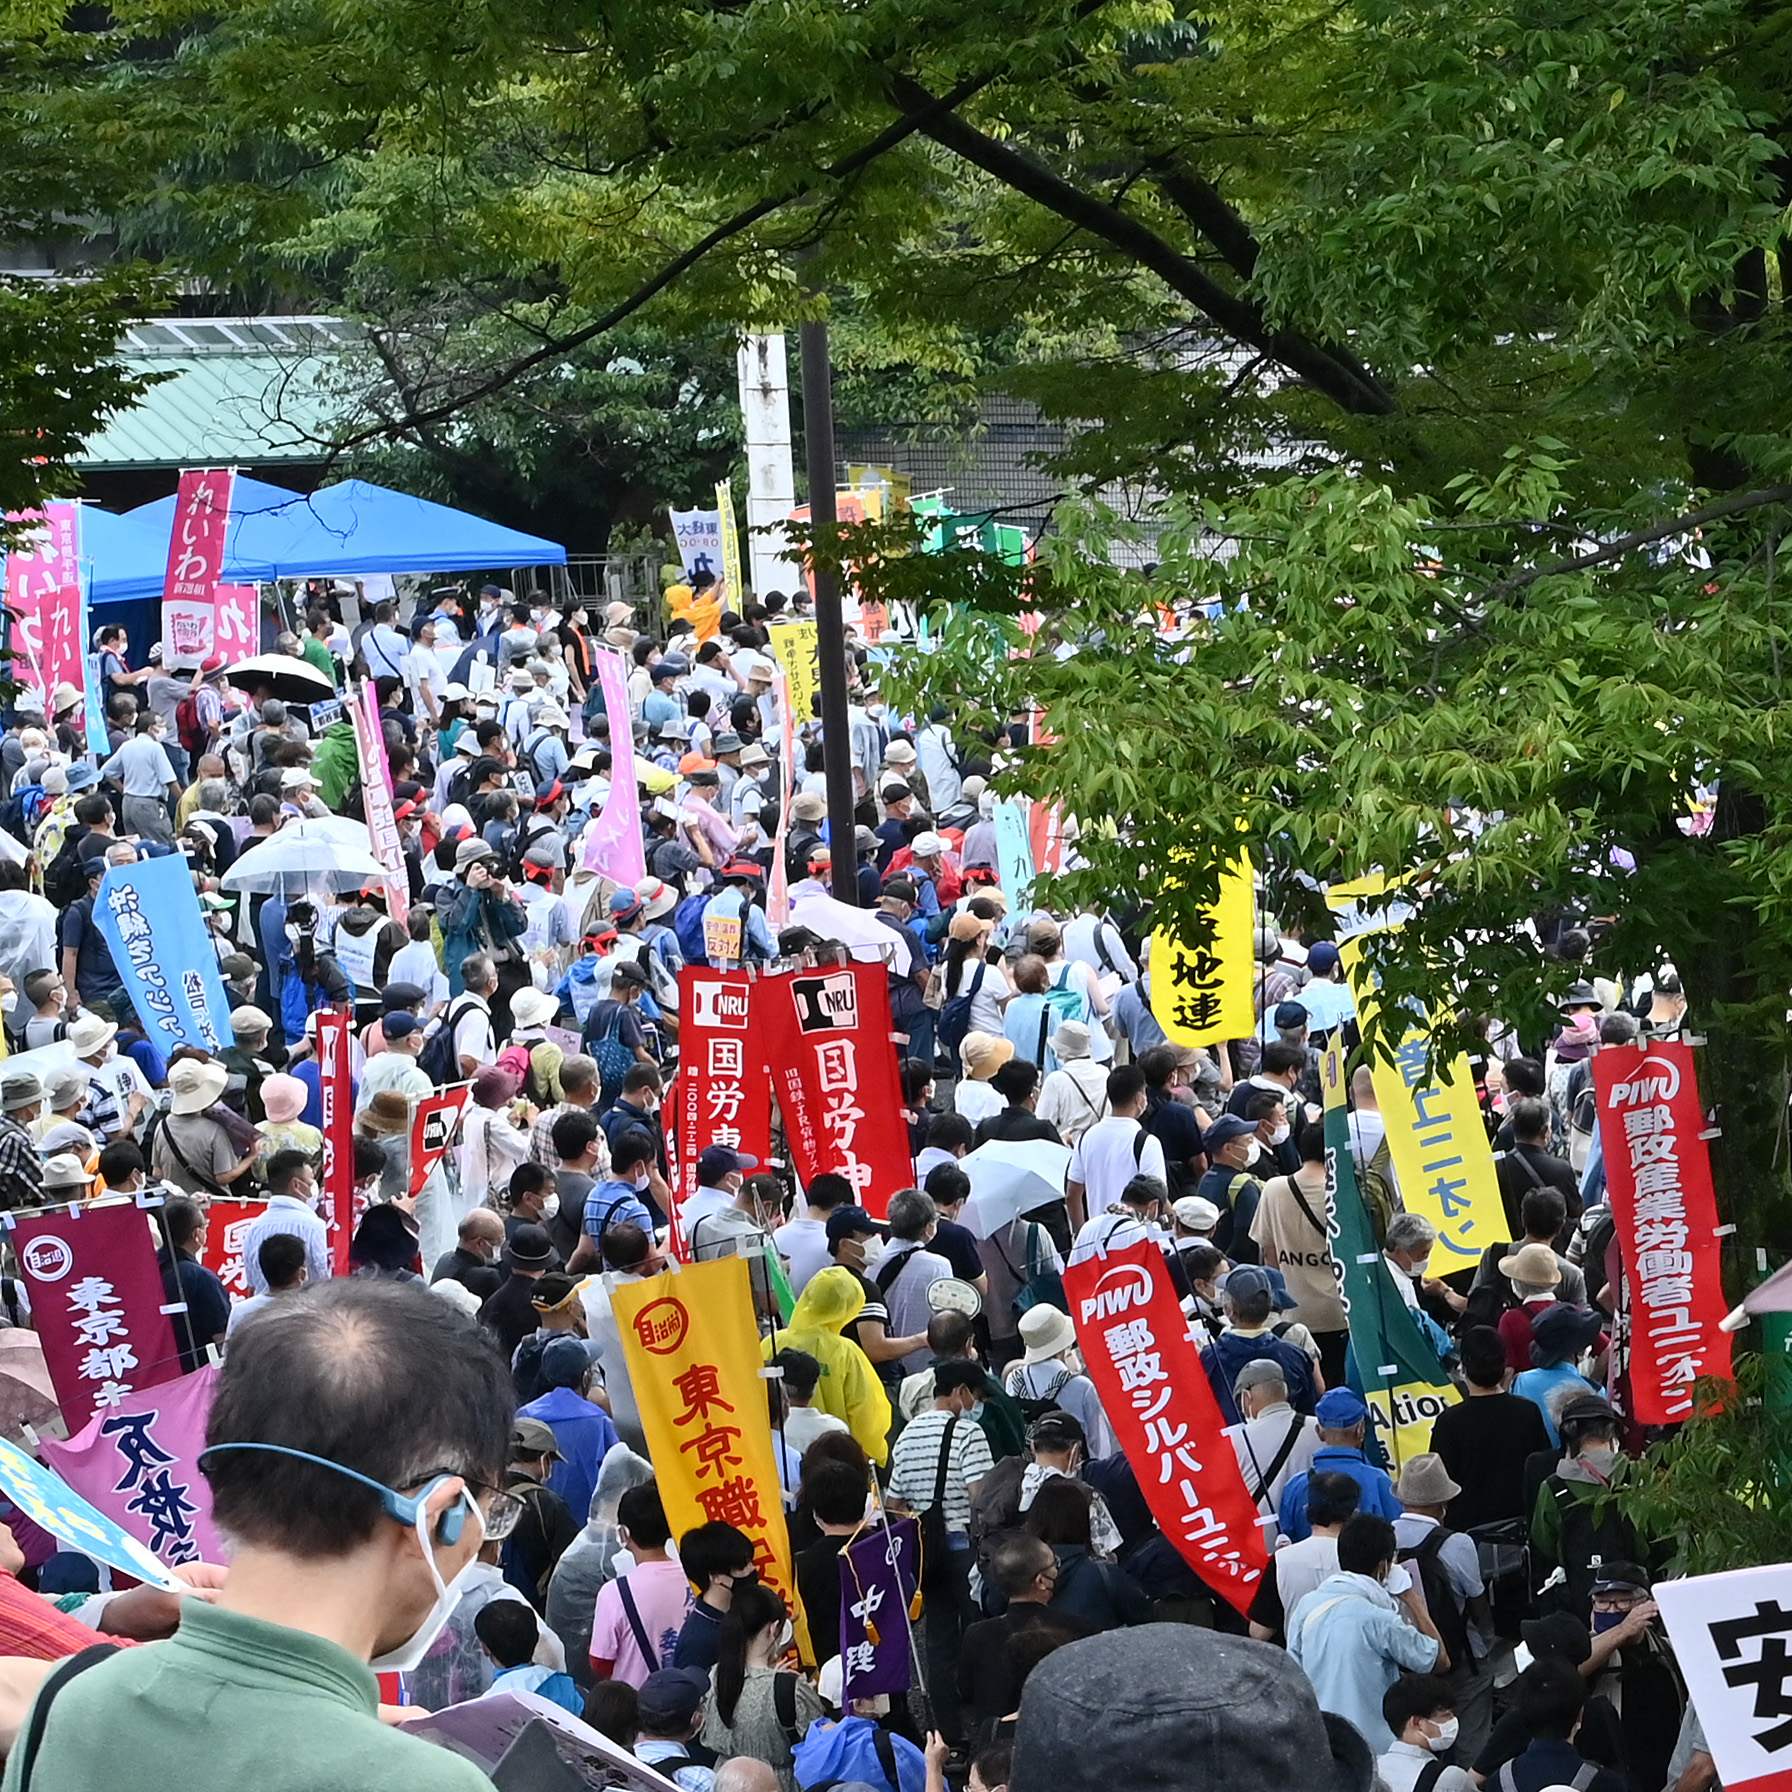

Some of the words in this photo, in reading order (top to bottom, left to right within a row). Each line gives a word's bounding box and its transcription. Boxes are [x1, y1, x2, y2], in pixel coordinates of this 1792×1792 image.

[175, 480, 214, 581] れいわ
[1168, 906, 1225, 1031] 地連
[717, 996, 749, 1016] NRU
[825, 988, 855, 1012] NRU
